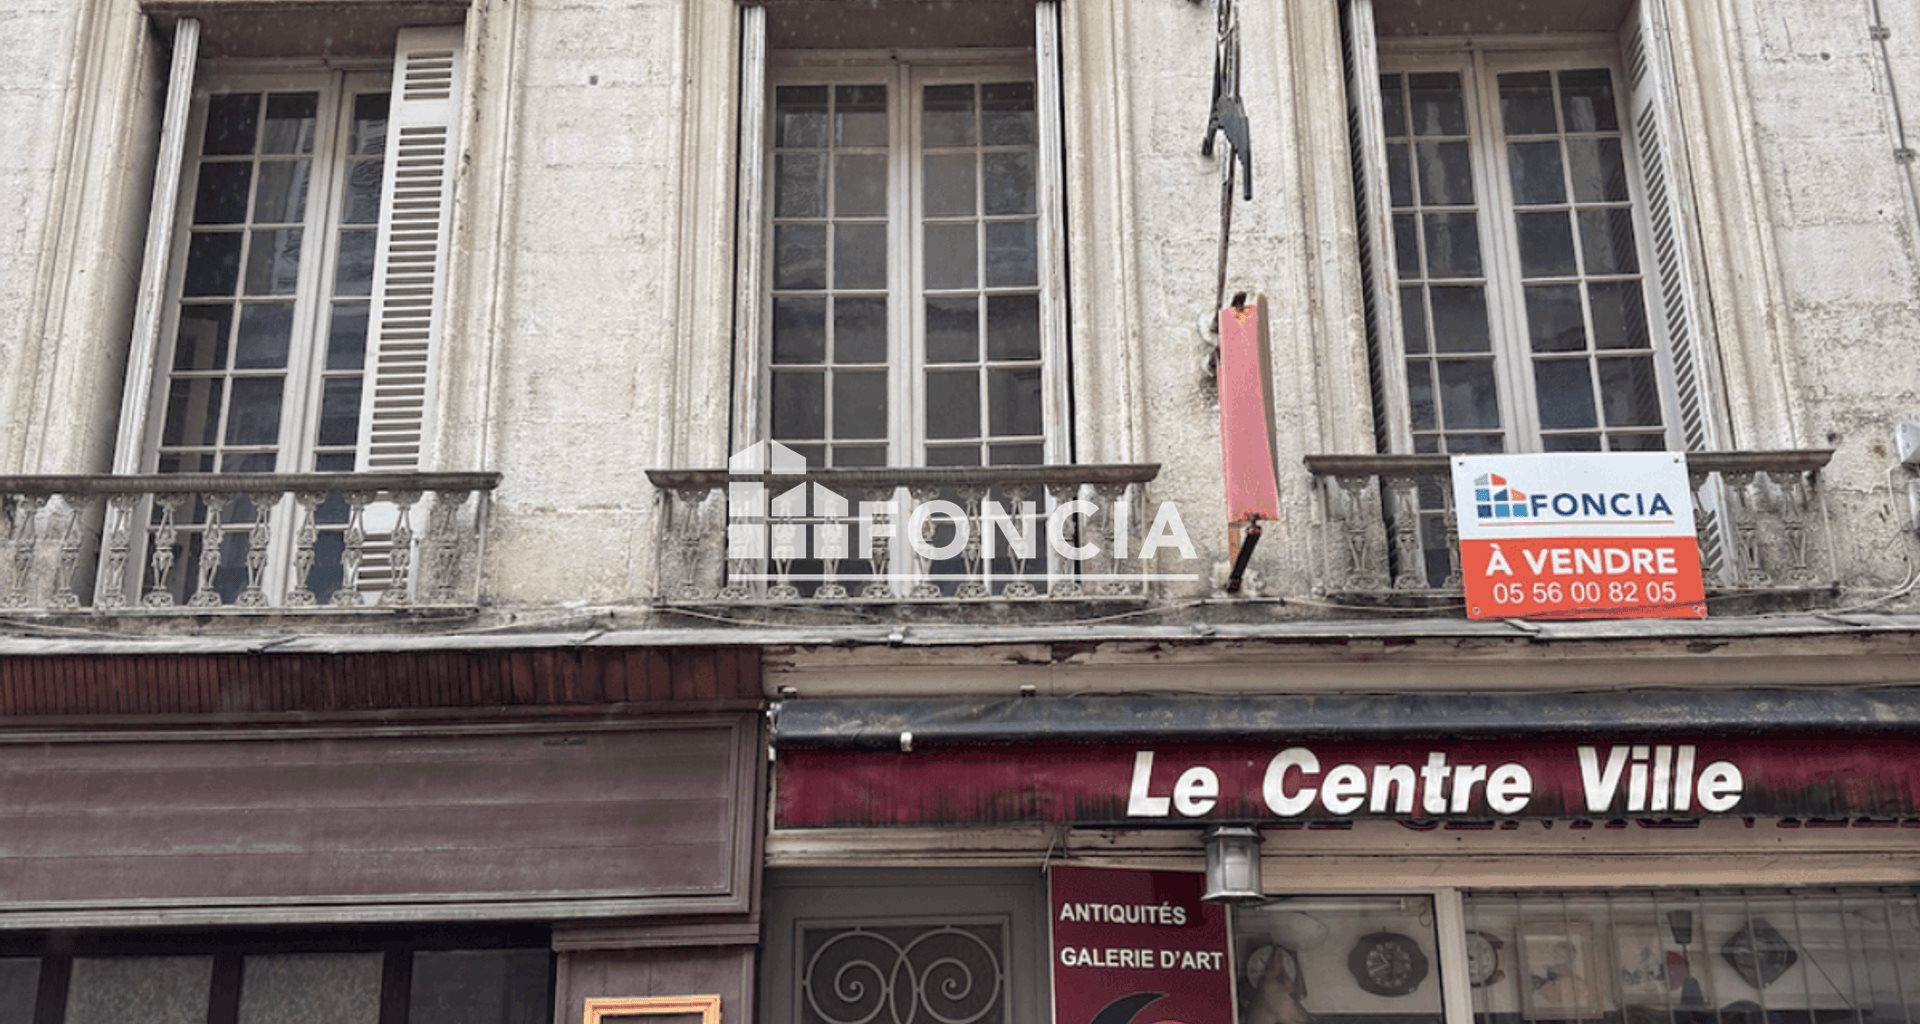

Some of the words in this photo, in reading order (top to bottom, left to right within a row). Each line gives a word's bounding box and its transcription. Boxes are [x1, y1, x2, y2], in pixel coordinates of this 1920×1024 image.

[1530, 492, 1672, 516] FONCIA
[1486, 544, 1514, 576] À
[1523, 548, 1678, 575] VENDRE
[1493, 583, 1524, 604] 05
[1532, 582, 1563, 603] 56
[1570, 582, 1600, 602] 00
[1608, 582, 1638, 602] 82
[1646, 581, 1676, 602] 05
[1126, 751, 1220, 816] Le
[1262, 746, 1533, 817] Centre
[1577, 744, 1744, 812] Ville
[1060, 902, 1186, 925] ANTIQUITÉS
[1060, 947, 1154, 968] GALERIE
[1161, 950, 1223, 970] D’ART
